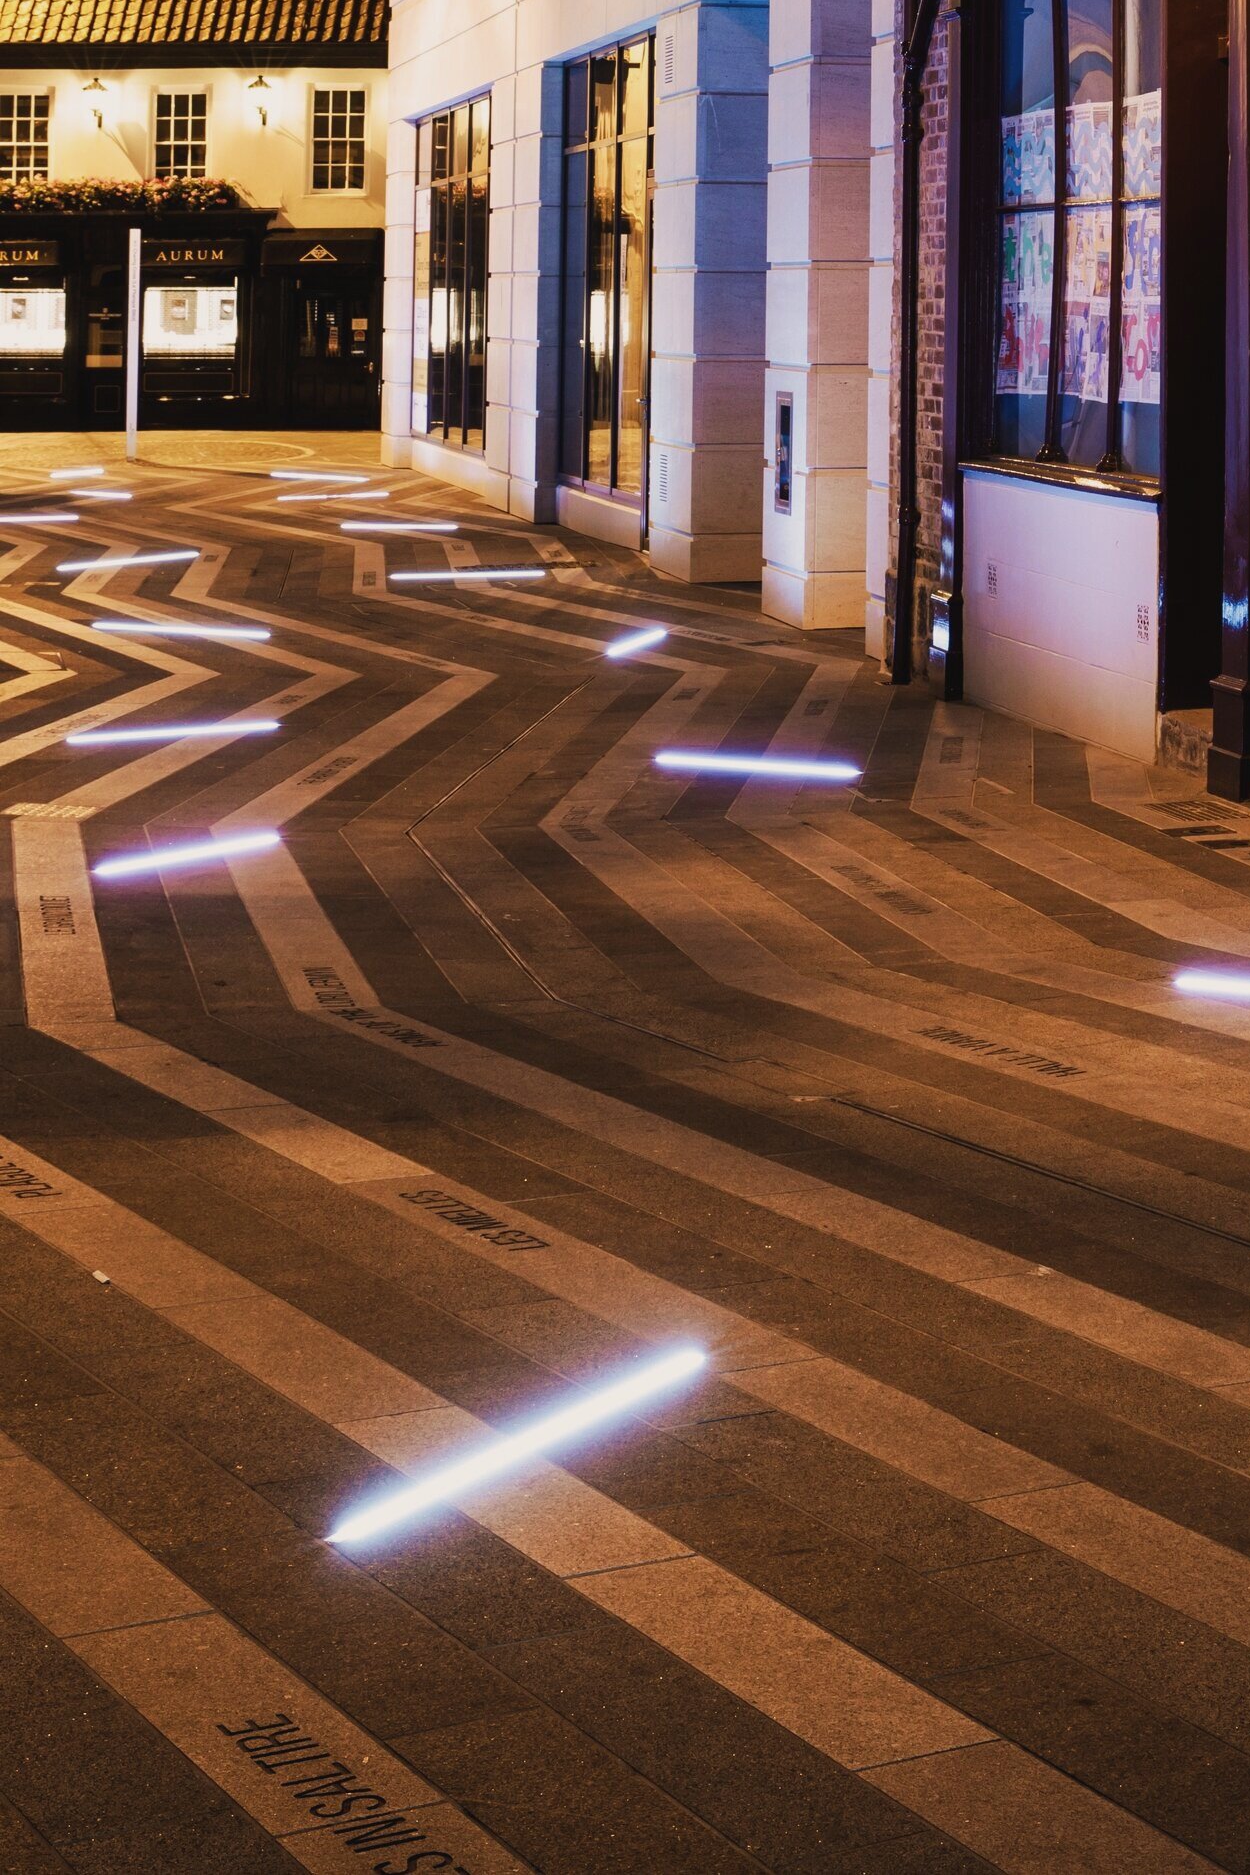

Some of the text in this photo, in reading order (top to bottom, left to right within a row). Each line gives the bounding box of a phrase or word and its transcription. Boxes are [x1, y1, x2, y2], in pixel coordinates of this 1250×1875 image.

[155, 249, 224, 261] AURUM
[998, 1054, 1088, 1078] HALLE
[398, 1189, 552, 1253] LES MIELLES
[215, 1711, 387, 1818] SALTIRE
[333, 1816, 427, 1854] IN
